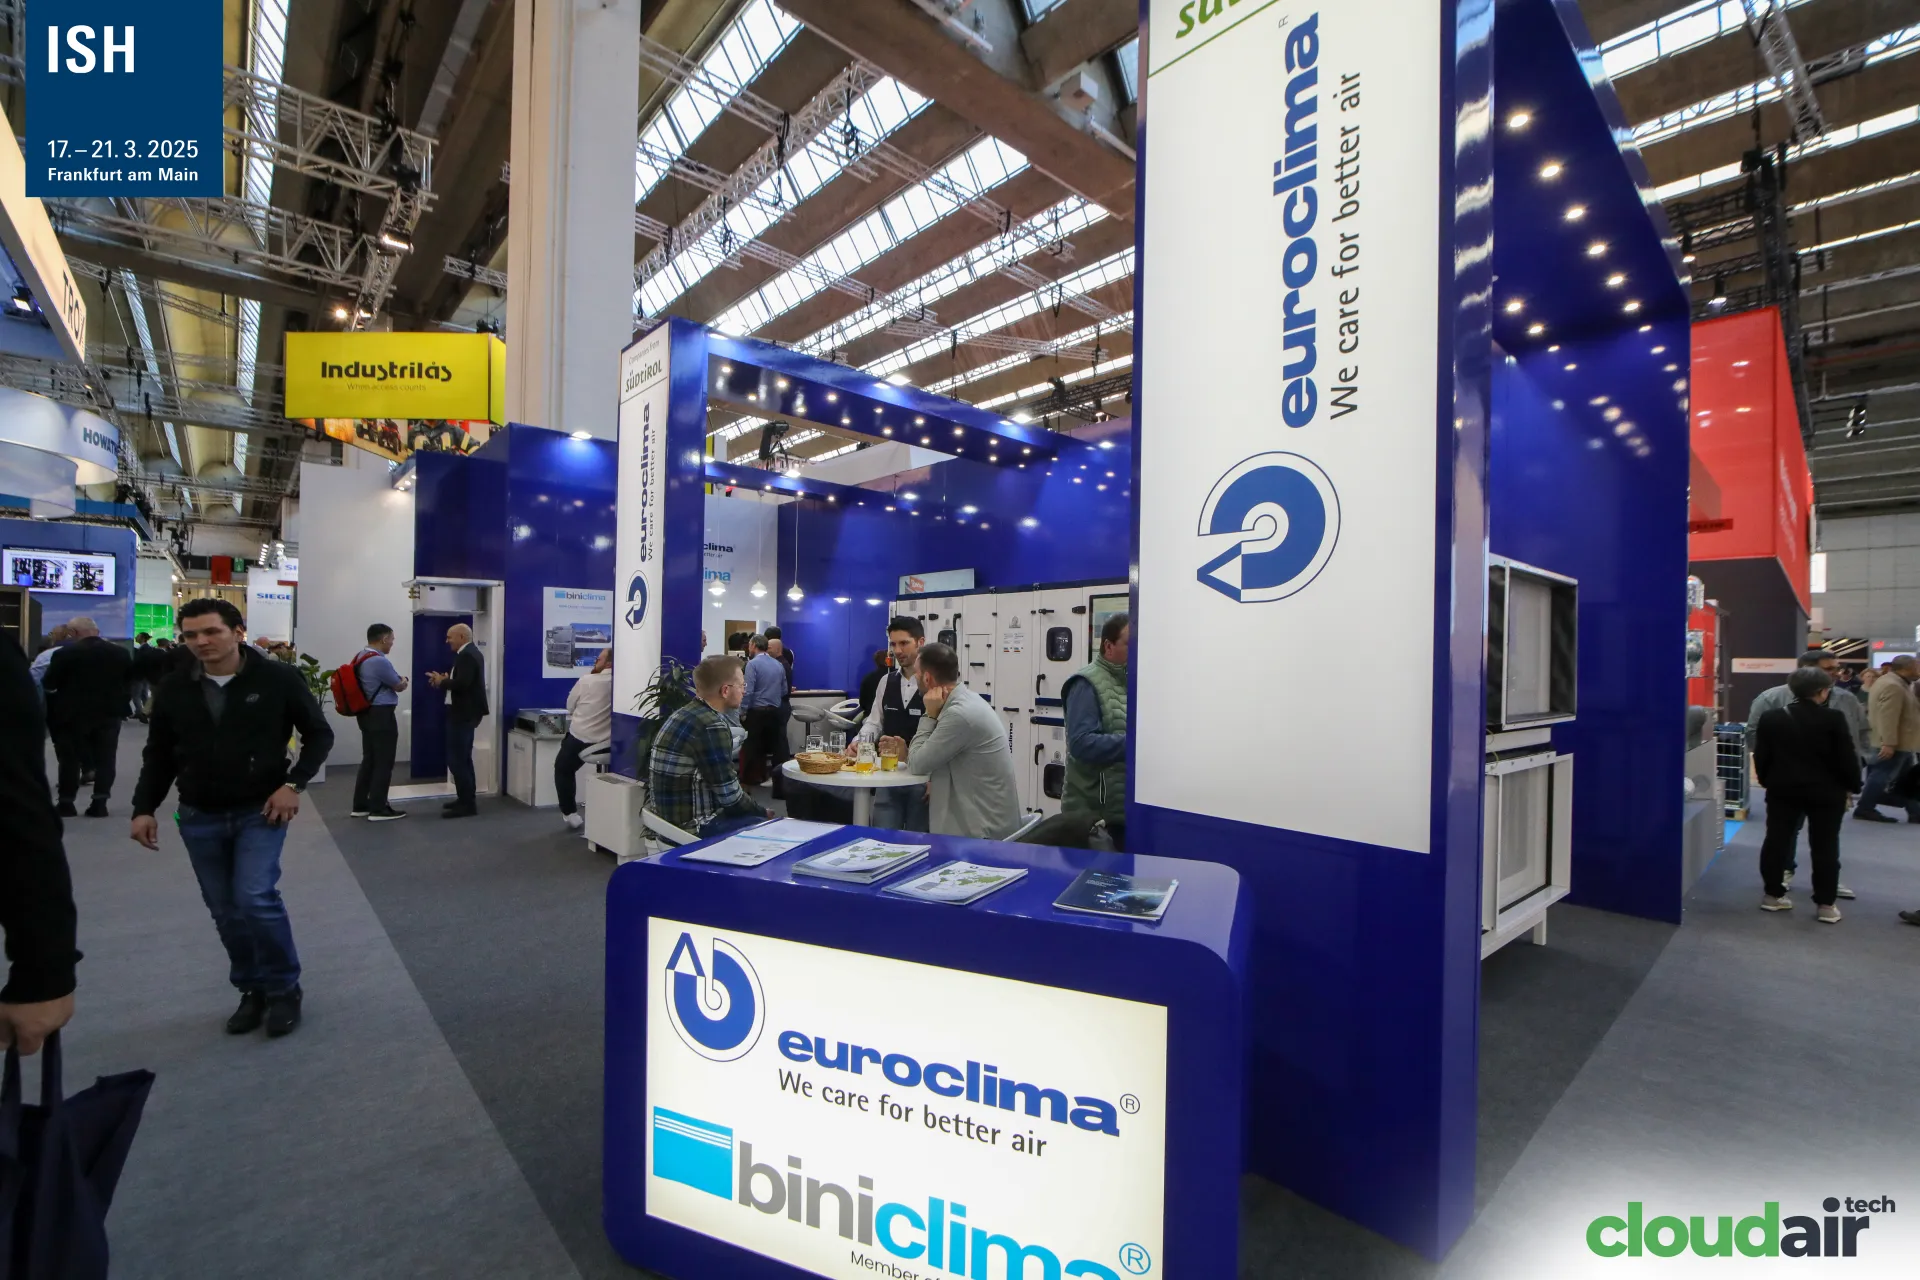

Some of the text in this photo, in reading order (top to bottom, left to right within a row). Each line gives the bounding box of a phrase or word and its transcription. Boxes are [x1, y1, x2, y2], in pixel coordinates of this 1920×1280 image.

[1330, 72, 1361, 420] We care for better air
[347, 382, 370, 391] When
[648, 541, 654, 561] We
[566, 592, 606, 601] biniclima
[778, 1068, 1047, 1157] We care for better air
[851, 1250, 919, 1280] Member
